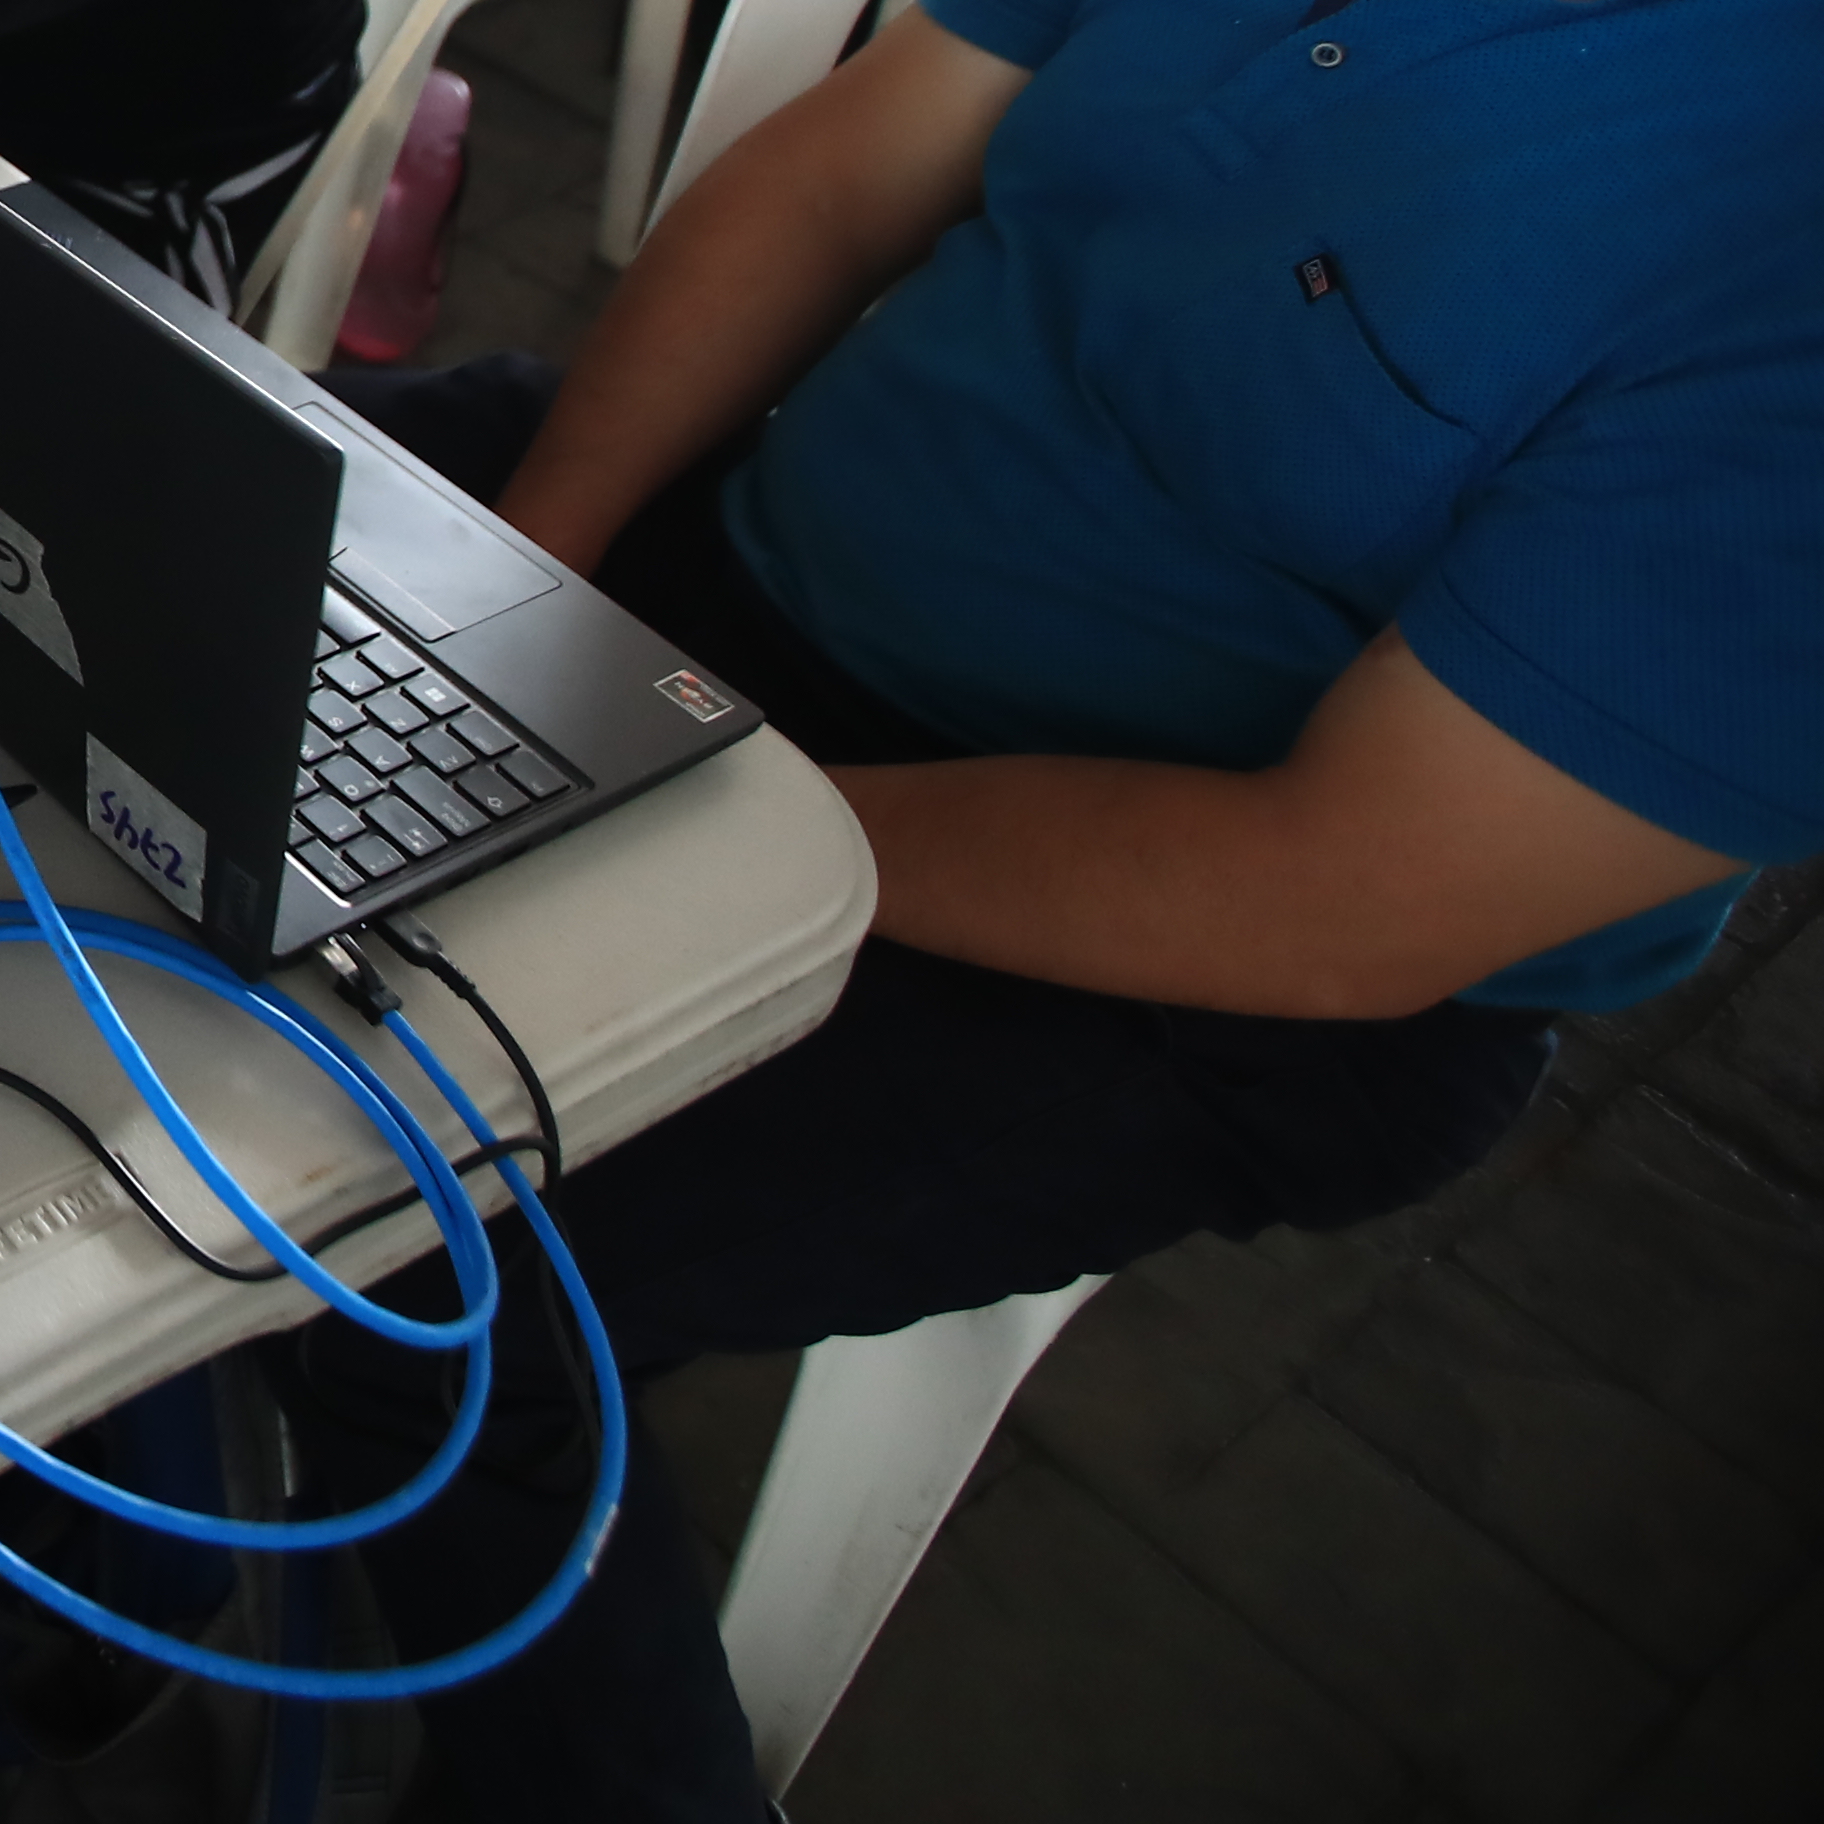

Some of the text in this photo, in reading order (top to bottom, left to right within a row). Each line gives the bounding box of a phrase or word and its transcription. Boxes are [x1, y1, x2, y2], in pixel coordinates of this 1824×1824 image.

[346, 680, 360, 691] X
[328, 717, 343, 728] S
[375, 756, 390, 766] A
